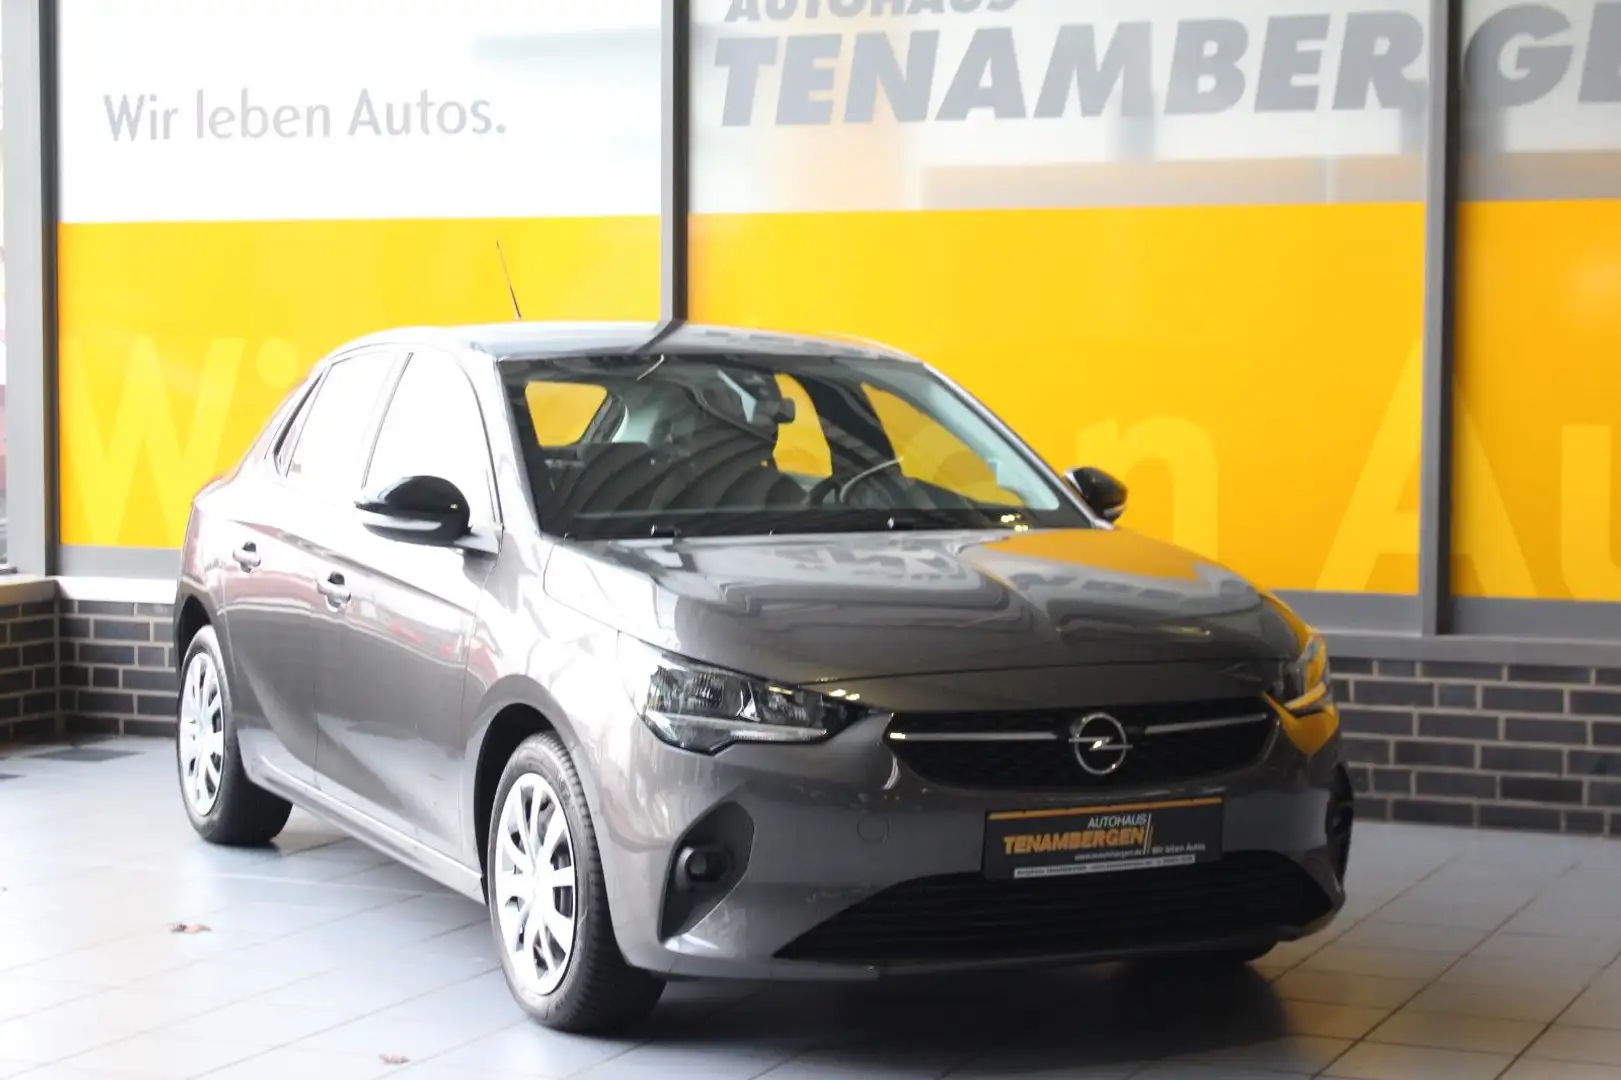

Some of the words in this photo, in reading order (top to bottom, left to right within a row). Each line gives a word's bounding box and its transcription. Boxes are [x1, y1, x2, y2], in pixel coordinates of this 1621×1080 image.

[103, 93, 179, 142] Wir
[196, 87, 331, 140] leben
[347, 87, 507, 137] Autos.
[1087, 813, 1147, 829] AUTOHAUS
[1003, 826, 1145, 855] TENAMBERGEN
